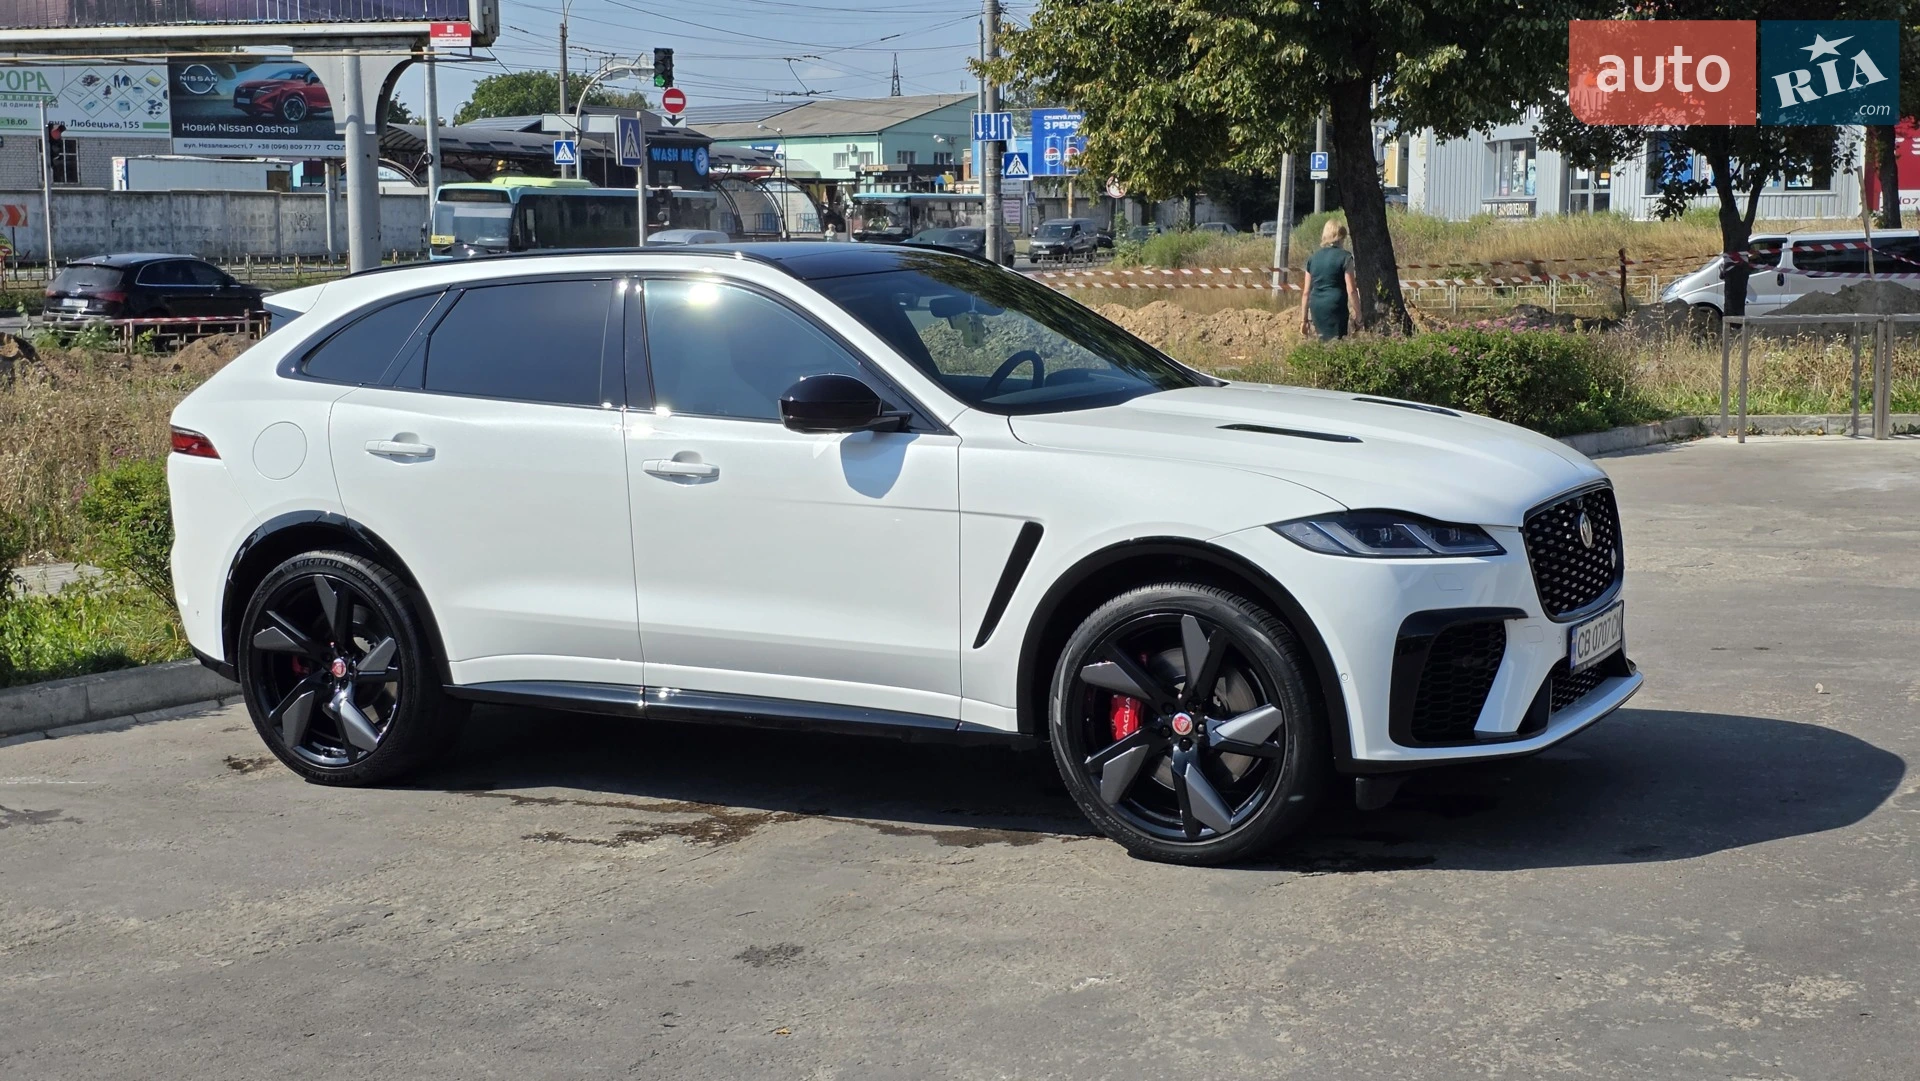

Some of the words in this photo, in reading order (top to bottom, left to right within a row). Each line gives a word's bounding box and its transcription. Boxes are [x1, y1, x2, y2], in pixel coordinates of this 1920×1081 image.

[6, 118, 28, 126] 18.00
[1052, 121, 1080, 130] PEPS
[182, 122, 216, 132] Новий
[218, 124, 253, 133] Nissan
[255, 124, 298, 136] Qashqai
[651, 148, 679, 161] WASH
[681, 148, 694, 161] ME
[1315, 154, 1325, 169] P
[296, 557, 344, 569] MICHELIN
[1578, 629, 1591, 659] CB
[1593, 618, 1611, 651] 0707
[1122, 697, 1131, 737] JAGUA
